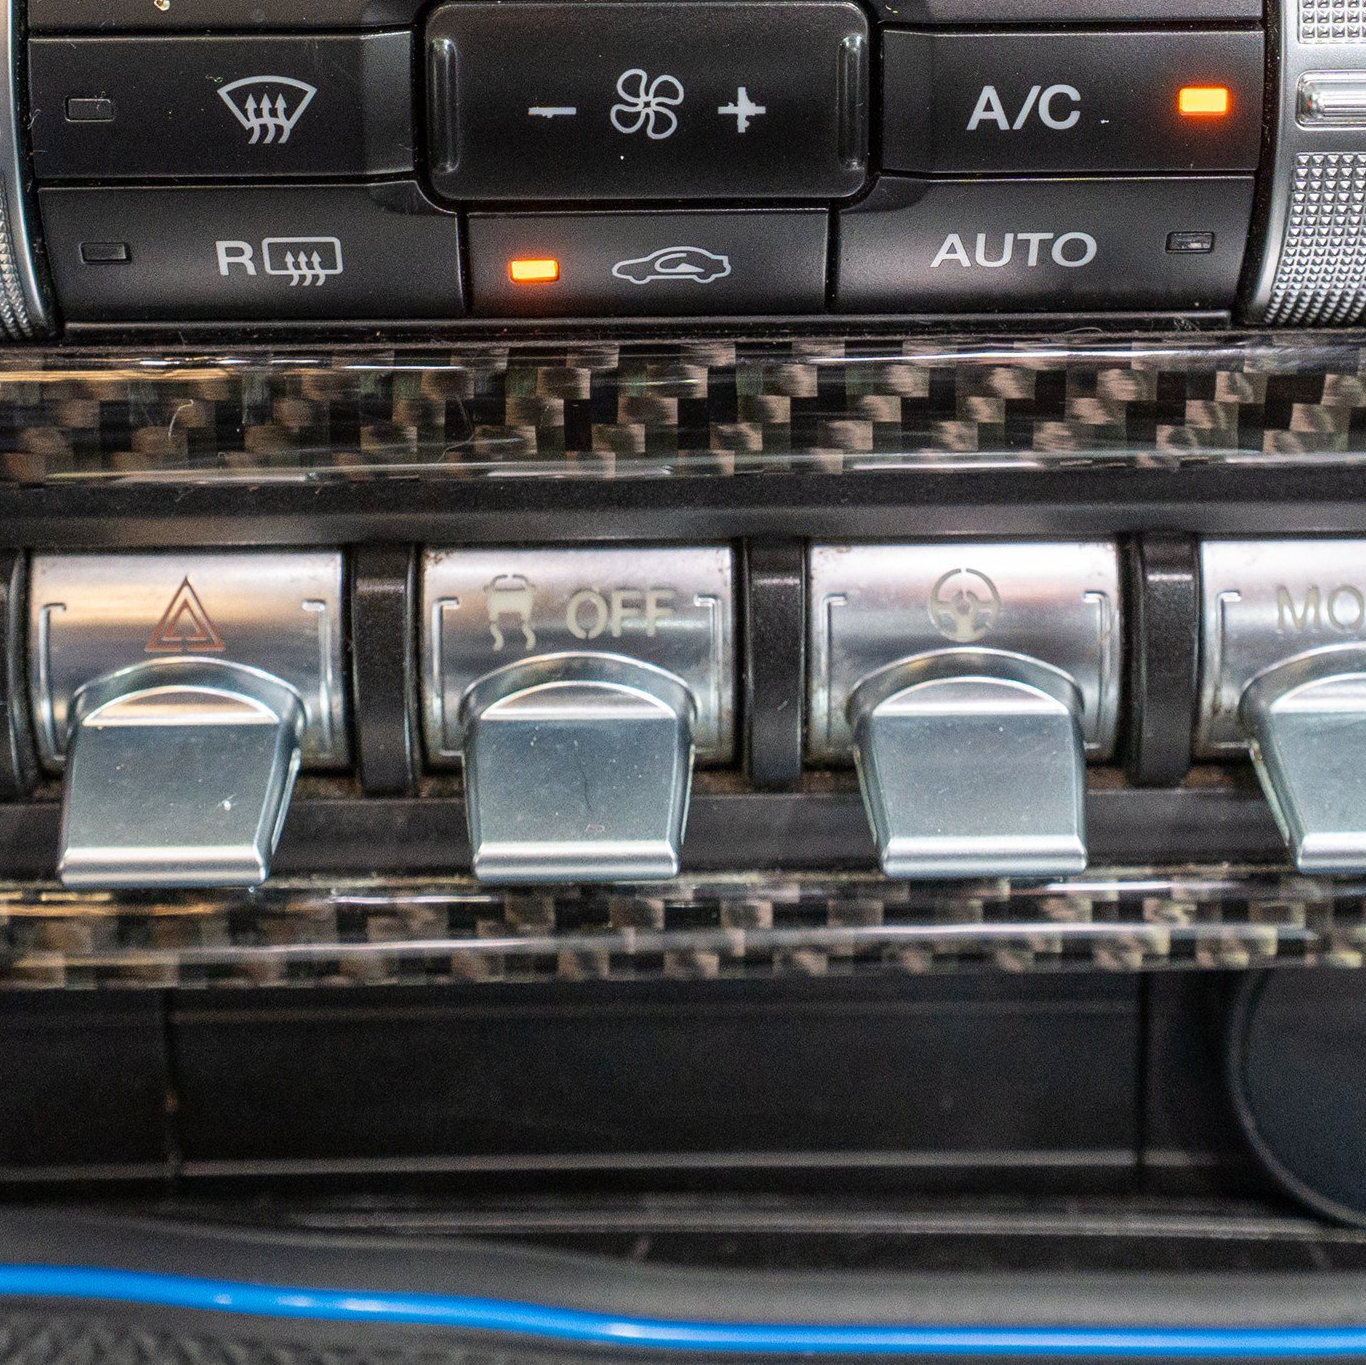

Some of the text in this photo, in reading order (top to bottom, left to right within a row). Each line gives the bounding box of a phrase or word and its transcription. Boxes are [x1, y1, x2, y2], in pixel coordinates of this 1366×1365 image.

[967, 84, 1081, 131] A/C
[216, 241, 256, 275] R
[931, 232, 1097, 268] AUTO
[565, 588, 674, 639] OFF
